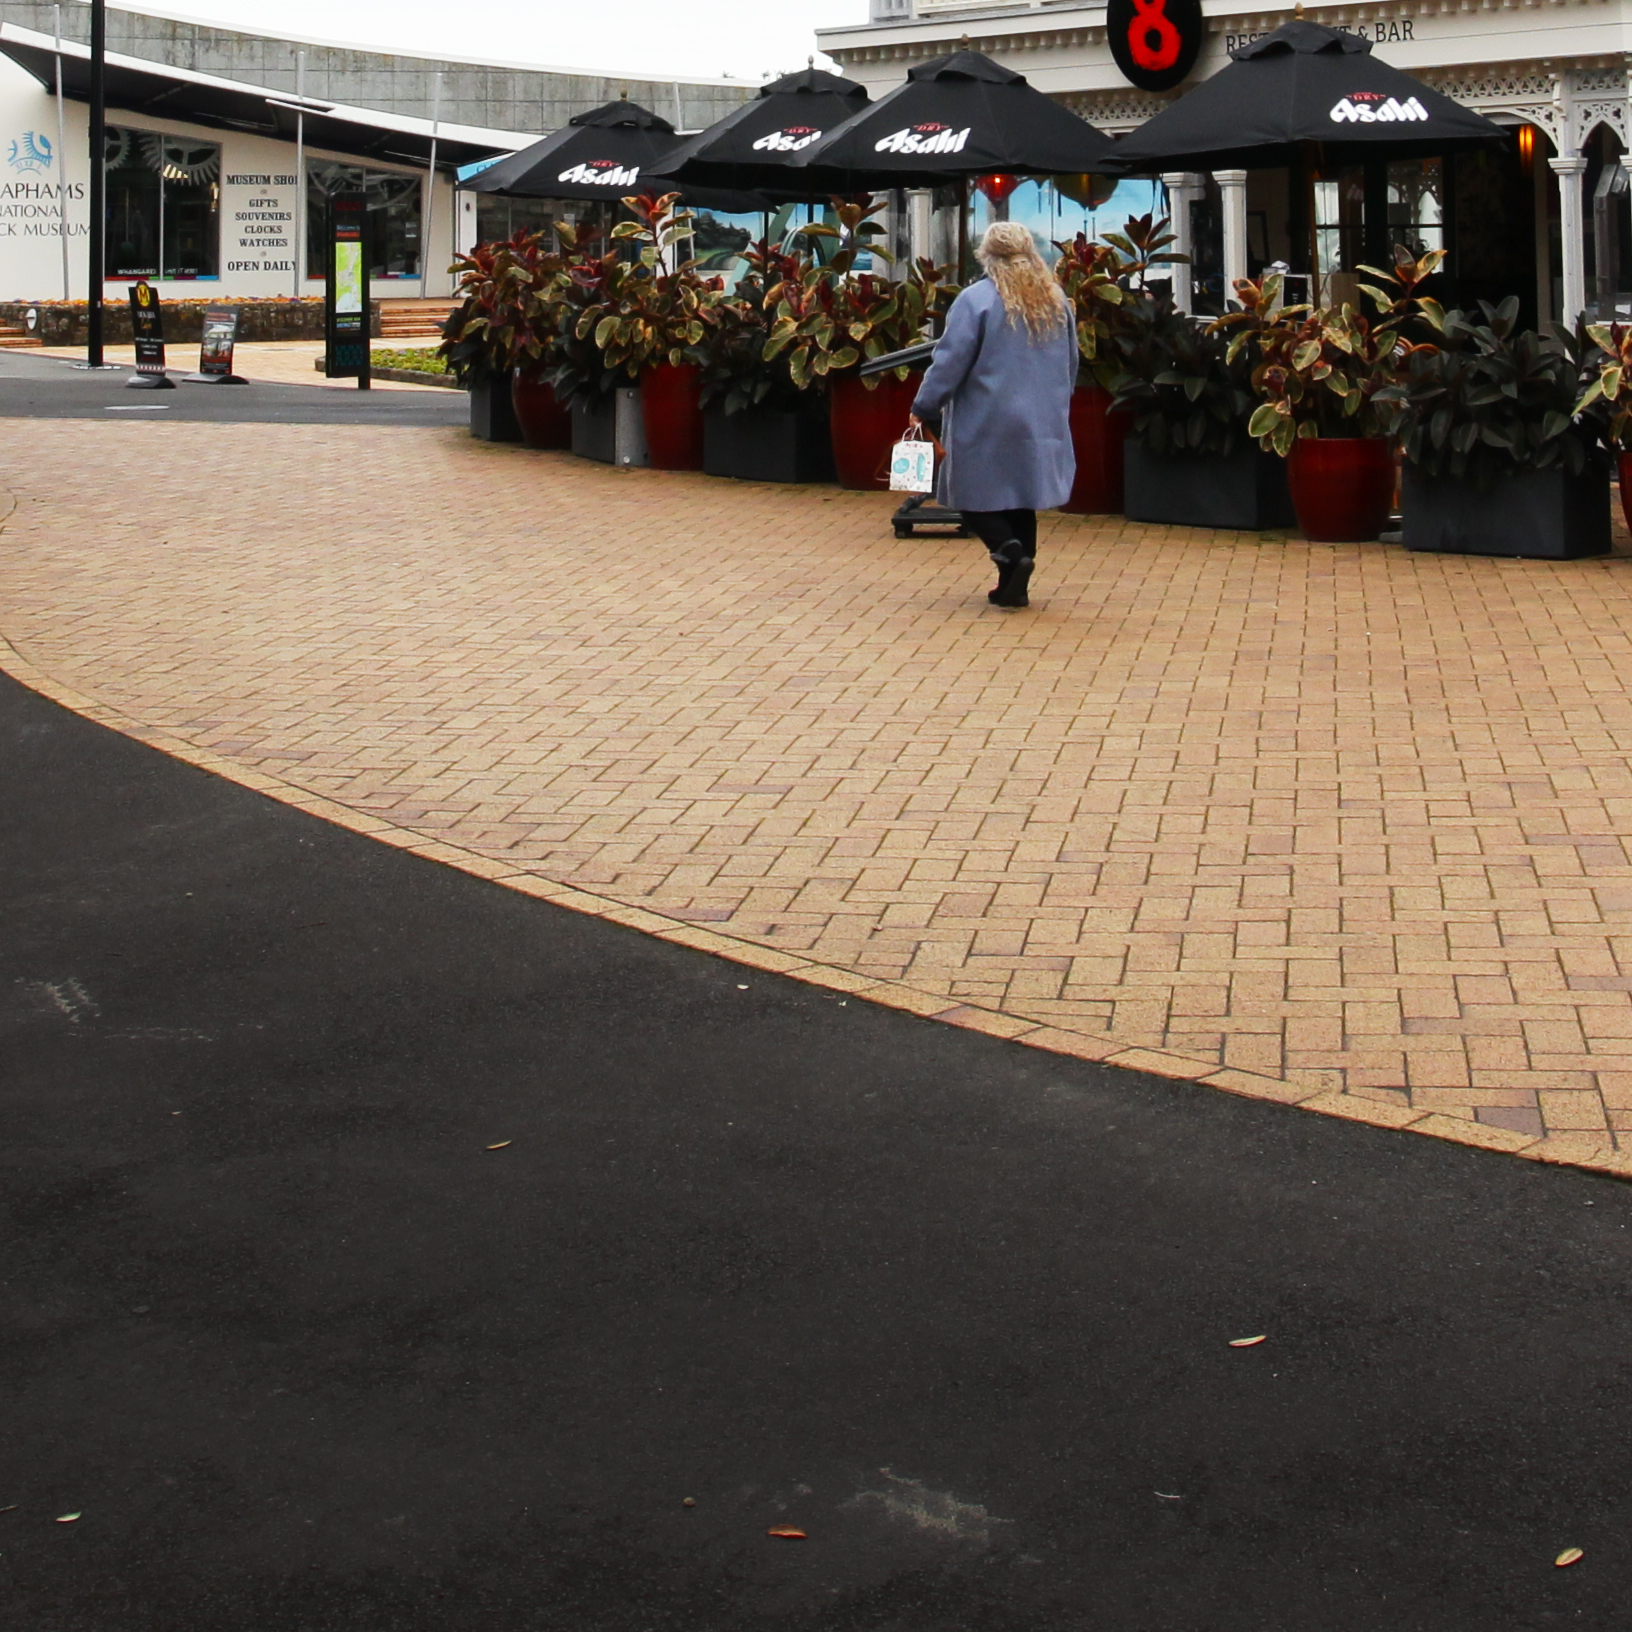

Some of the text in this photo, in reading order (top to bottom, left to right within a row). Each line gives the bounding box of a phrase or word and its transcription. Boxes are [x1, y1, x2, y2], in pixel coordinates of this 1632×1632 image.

[1374, 20, 1415, 43] BAR
[1329, 96, 1429, 123] Asahi
[753, 130, 822, 151] Asa
[875, 127, 970, 154] Asahi
[226, 174, 271, 185] MUSEUM
[558, 163, 640, 187] Asahi
[249, 199, 278, 208] GIFTS
[235, 212, 292, 221] SOUVENIRS
[244, 225, 283, 234] CLOCKS
[239, 238, 288, 247] WATCHES
[227, 261, 259, 271] OPEN
